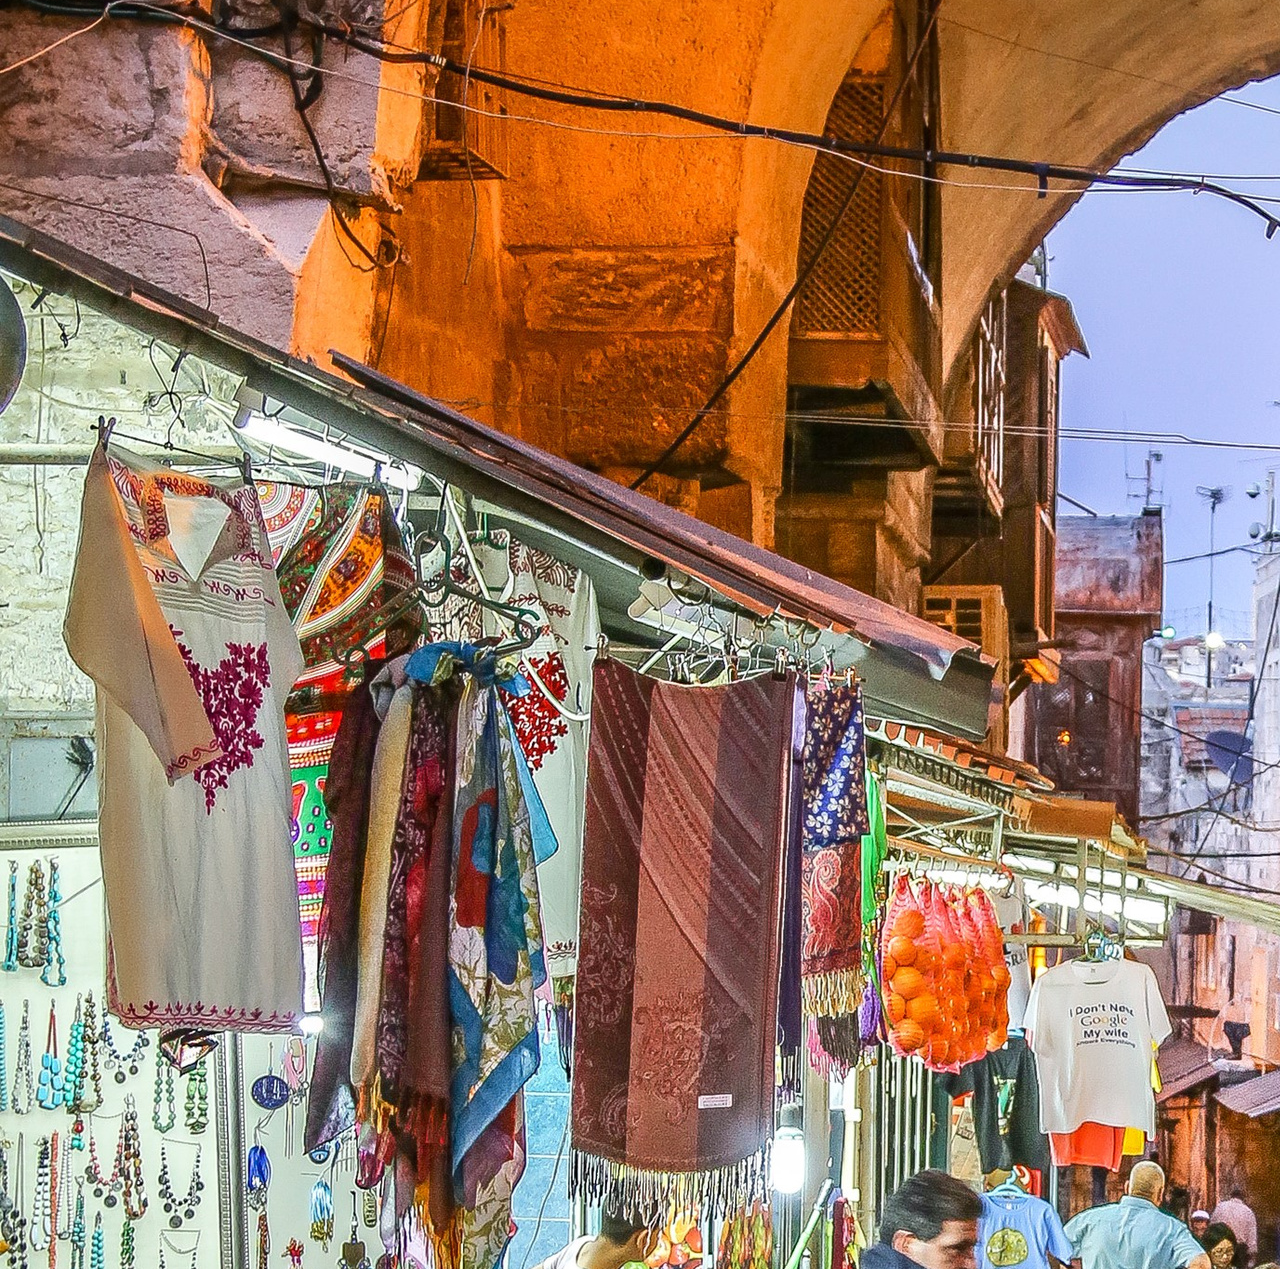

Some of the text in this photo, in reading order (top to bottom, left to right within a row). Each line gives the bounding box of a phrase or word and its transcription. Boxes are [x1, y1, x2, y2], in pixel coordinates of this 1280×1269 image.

[1075, 1003, 1106, 1015] Don't
[1080, 1014, 1128, 1028] Google
[1083, 1028, 1129, 1039] My wife
